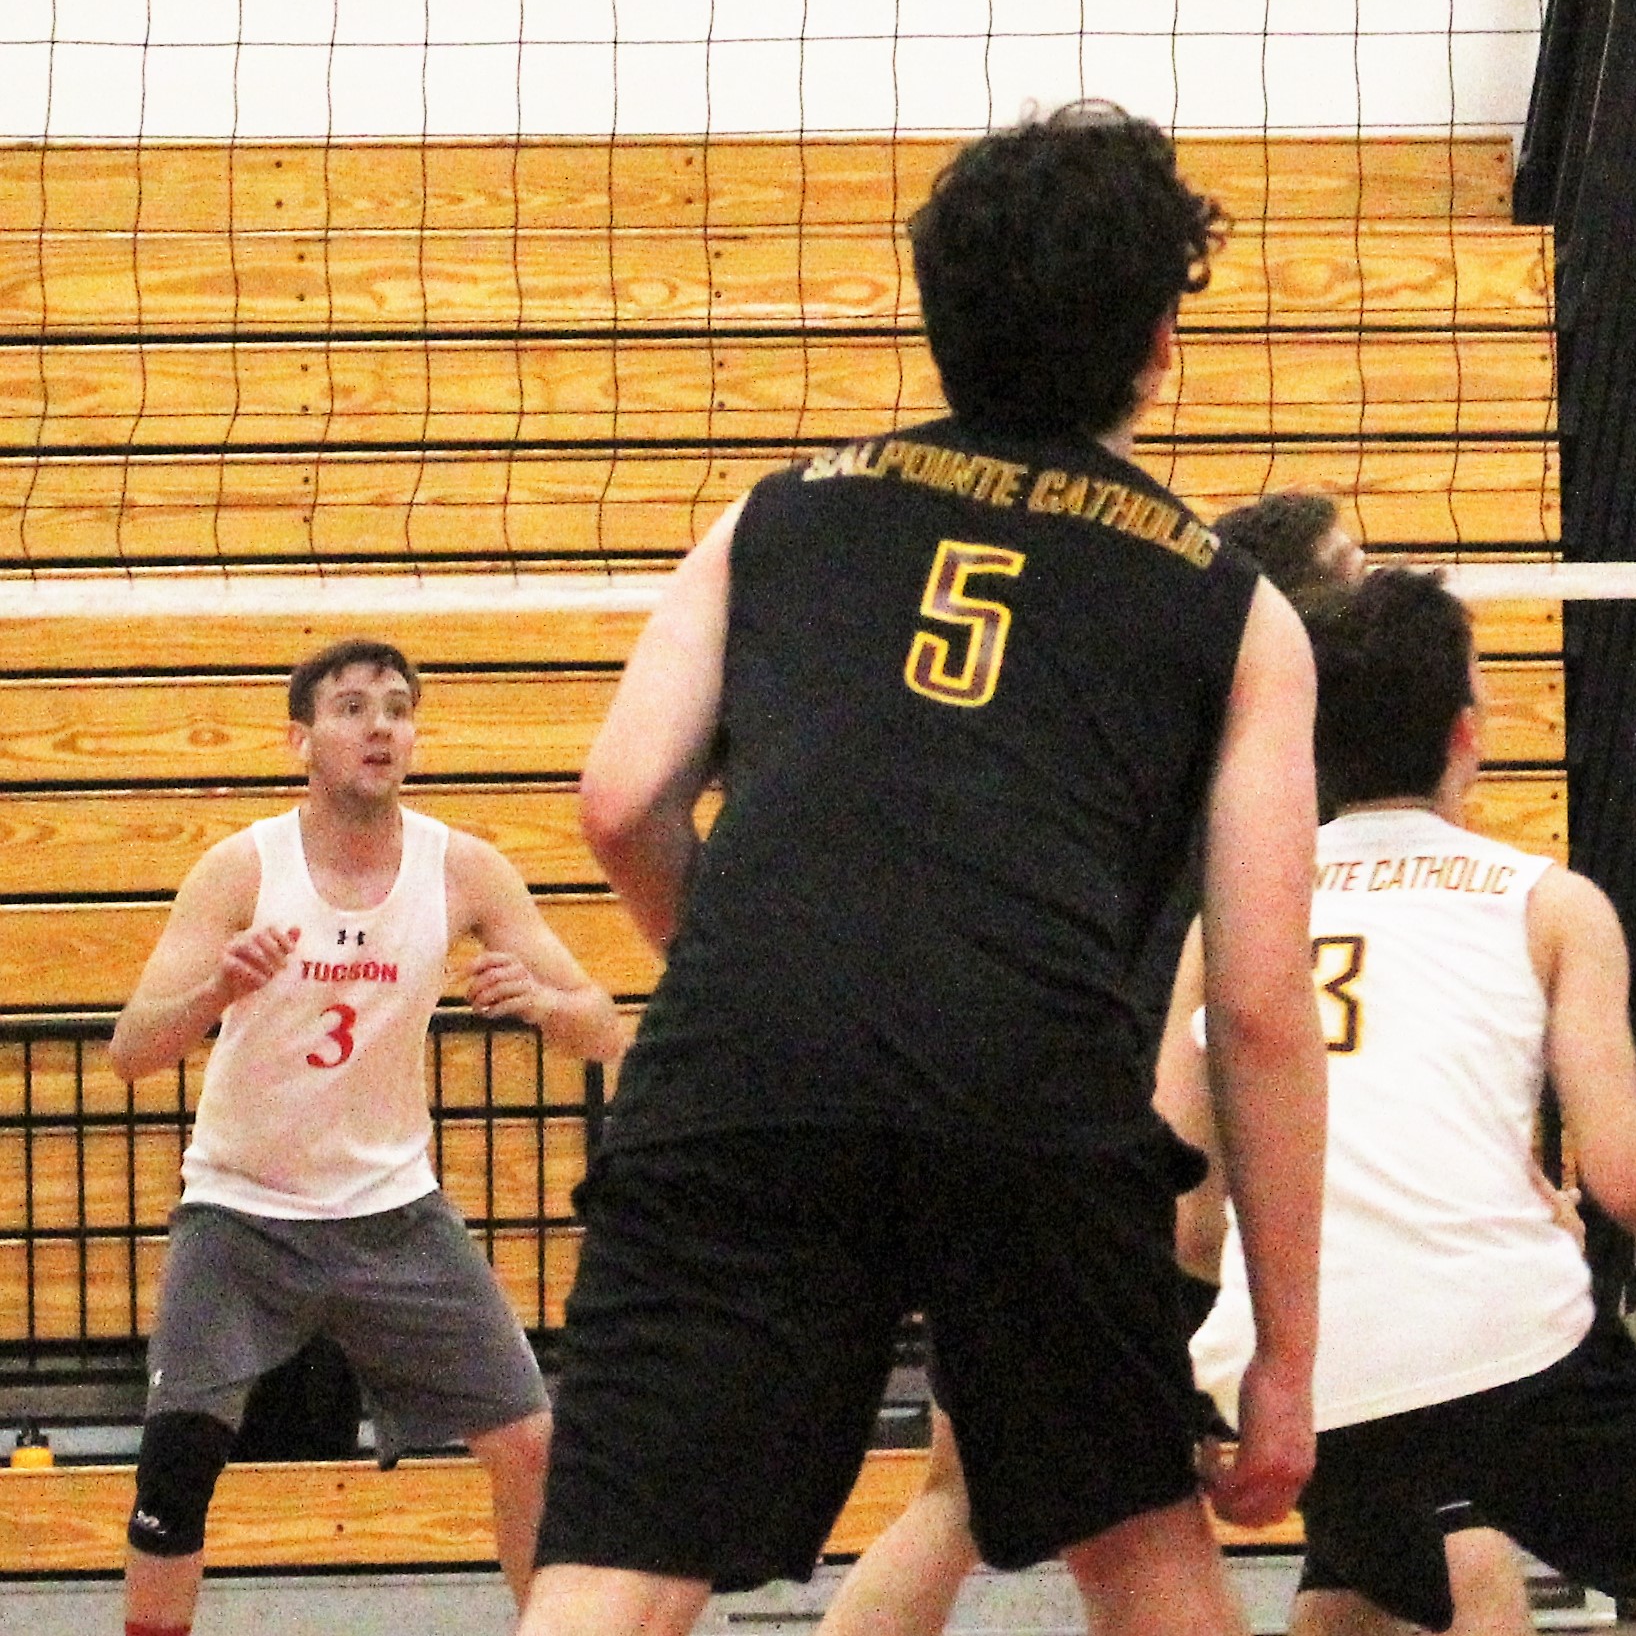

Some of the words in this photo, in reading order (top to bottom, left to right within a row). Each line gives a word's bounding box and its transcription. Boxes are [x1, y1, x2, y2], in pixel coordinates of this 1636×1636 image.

[904, 538, 1027, 709] 5
[1367, 856, 1518, 895] CATHOLIC
[301, 960, 399, 983] TUCSON
[306, 1003, 357, 1069] 3
